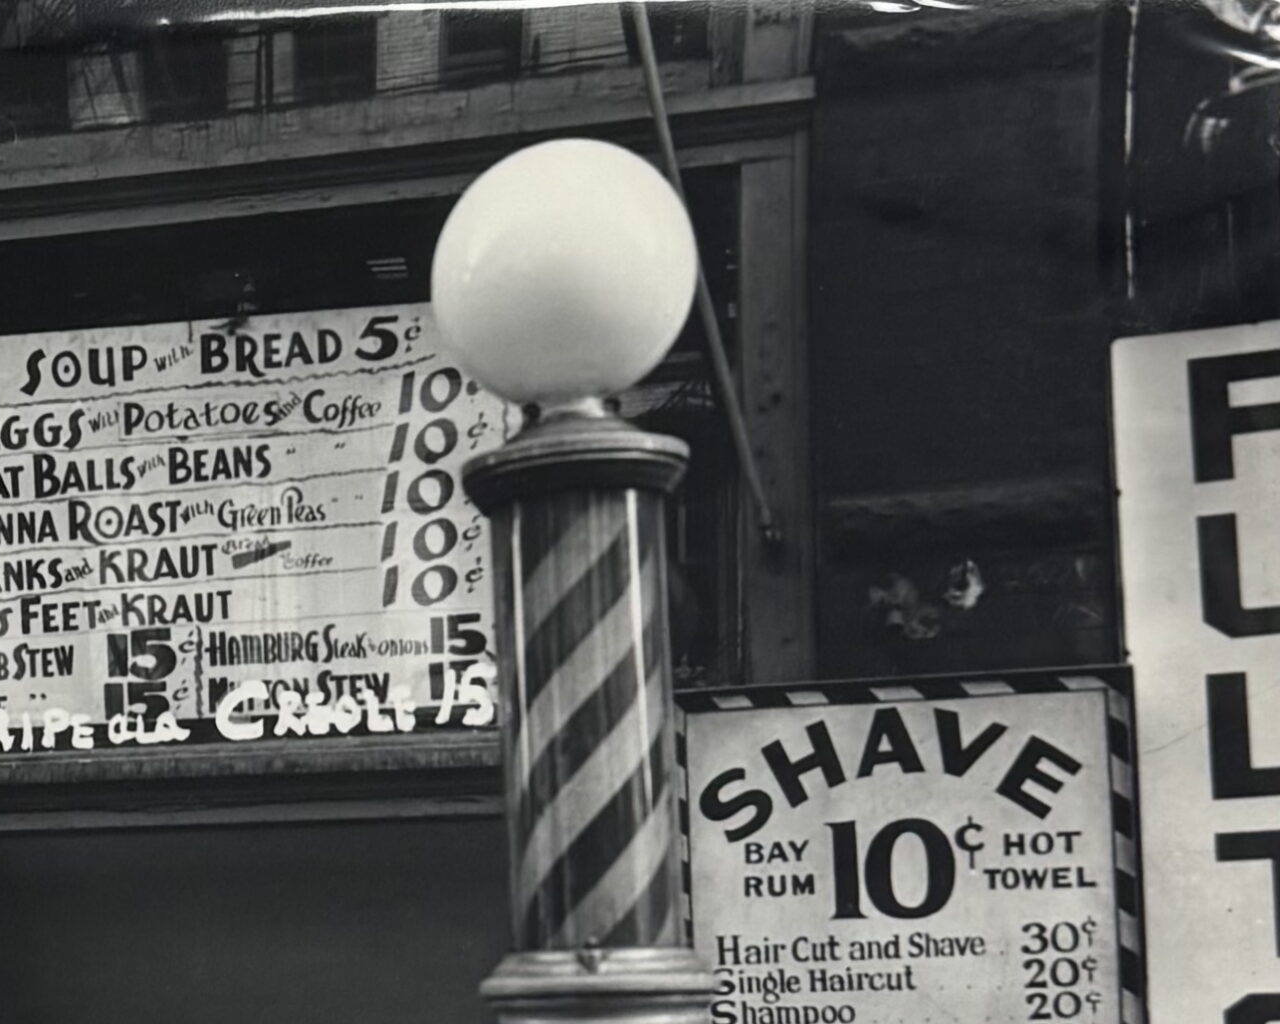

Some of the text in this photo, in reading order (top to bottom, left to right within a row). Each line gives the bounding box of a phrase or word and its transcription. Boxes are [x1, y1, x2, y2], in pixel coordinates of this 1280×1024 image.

[20, 345, 147, 395] SOUP
[199, 328, 342, 378] BREAD
[124, 399, 279, 436] Potatoes
[302, 389, 382, 427] Coffee
[34, 452, 136, 497] BALLS
[169, 445, 272, 485] BEANS
[68, 500, 184, 546] ROAST
[217, 499, 282, 531] Green
[99, 542, 218, 584] KRAUT
[20, 598, 97, 636] FEET
[121, 590, 232, 627] KRAUT
[12, 644, 74, 681] STEW
[317, 671, 389, 703] STEW
[699, 706, 1082, 844] SHAVE
[744, 839, 816, 898] BAY RUM
[983, 831, 1097, 890] HOT TOWEL
[716, 934, 787, 966] Hair
[791, 936, 840, 963] Cut
[907, 932, 986, 959] Shave
[713, 969, 802, 1002] Single
[808, 966, 917, 993] Haircut
